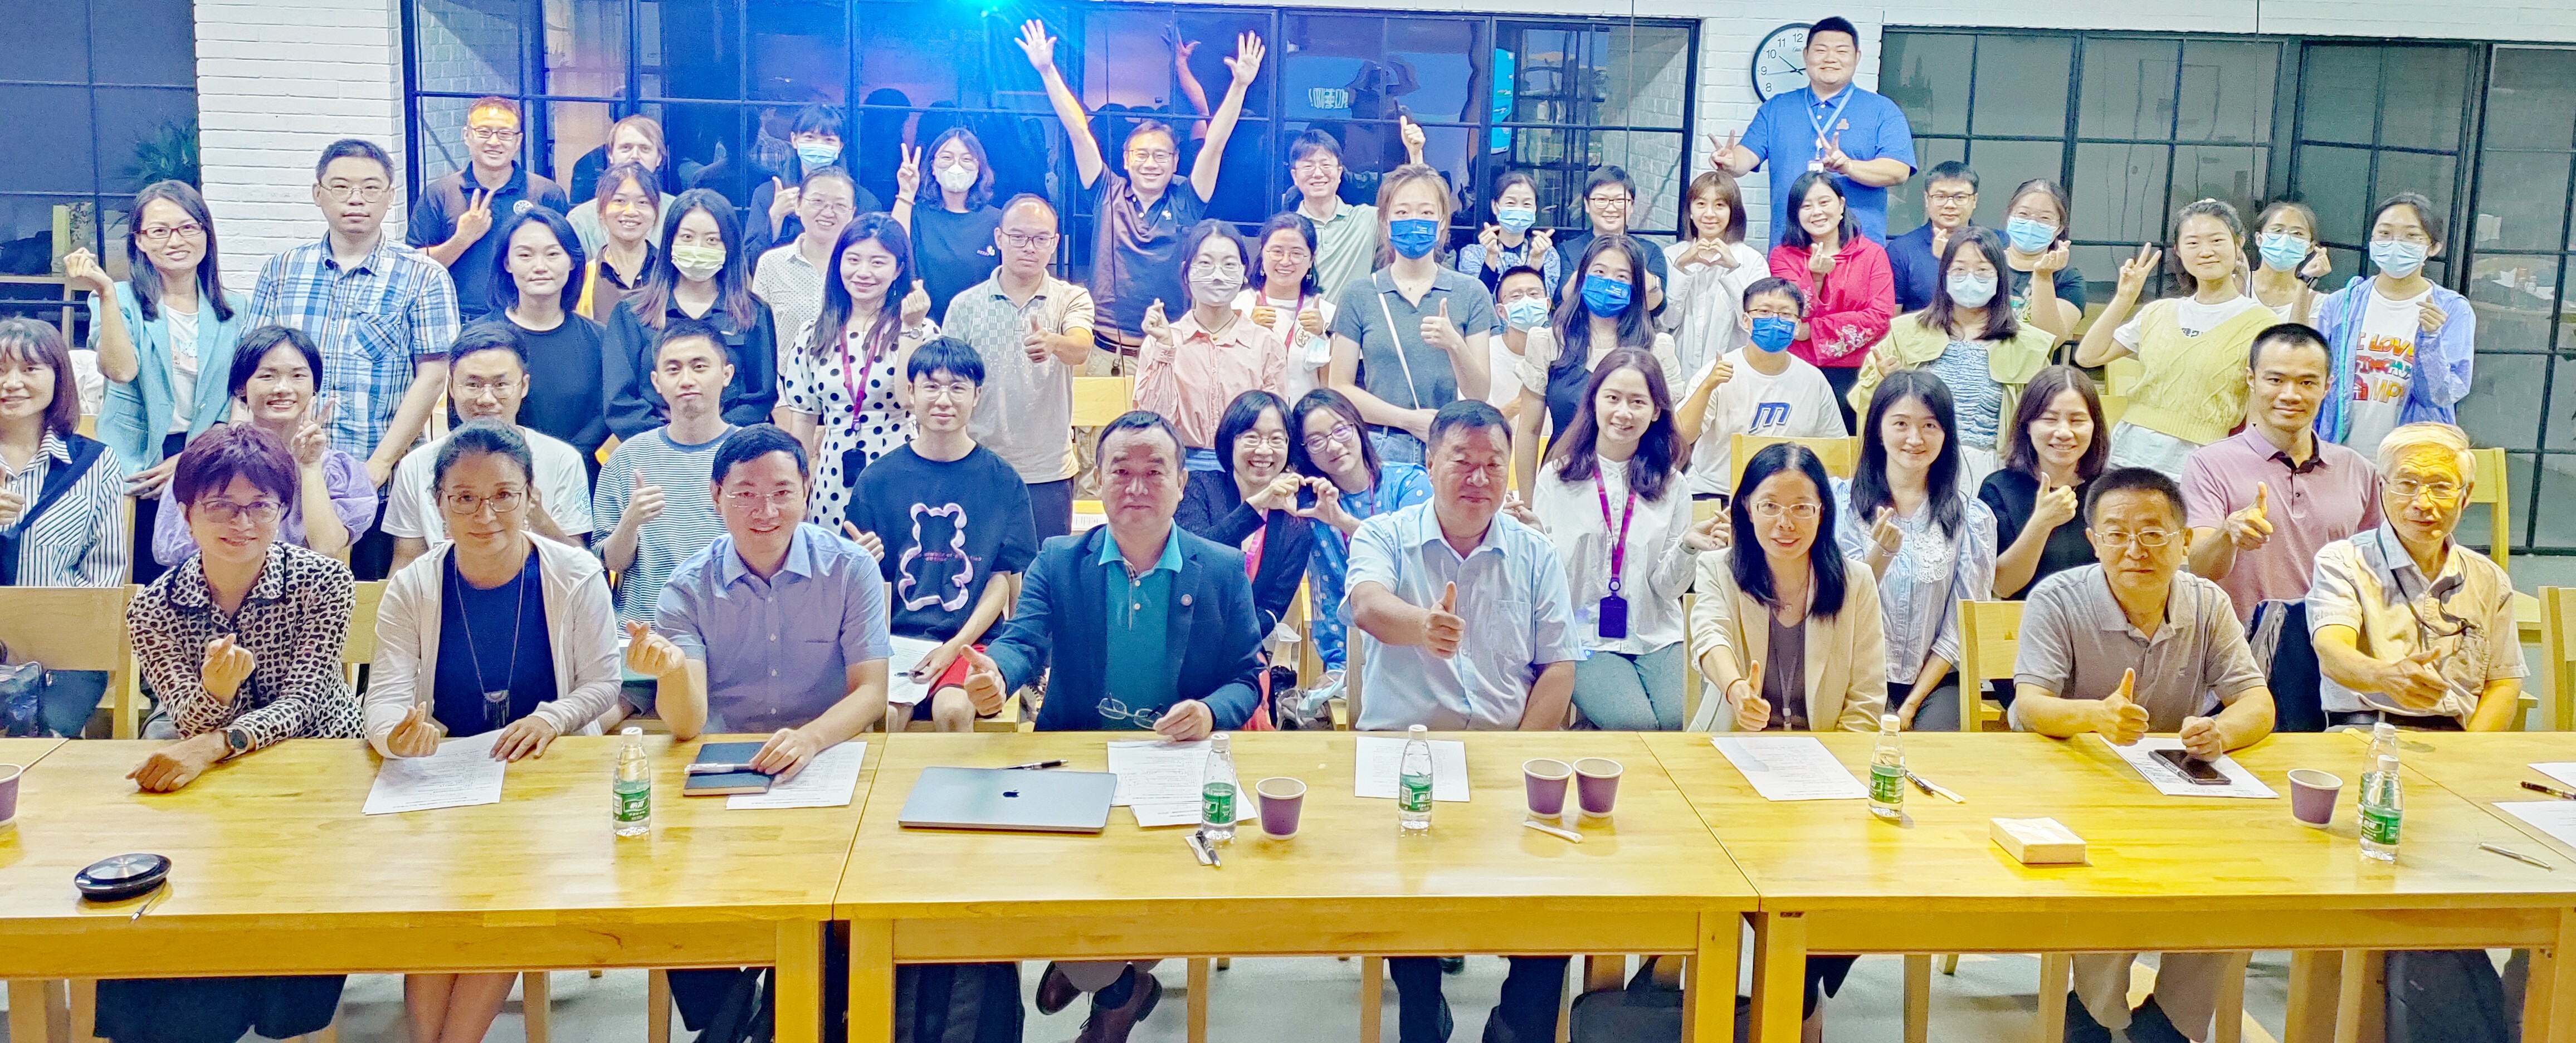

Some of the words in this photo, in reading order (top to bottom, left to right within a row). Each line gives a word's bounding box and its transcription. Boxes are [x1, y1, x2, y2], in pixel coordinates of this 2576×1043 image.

[1793, 33, 1803, 42] 12
[1777, 38, 1785, 47] 11
[1766, 49, 1777, 58] 10
[1760, 66, 1767, 75] 9
[1765, 82, 1772, 92] 8
